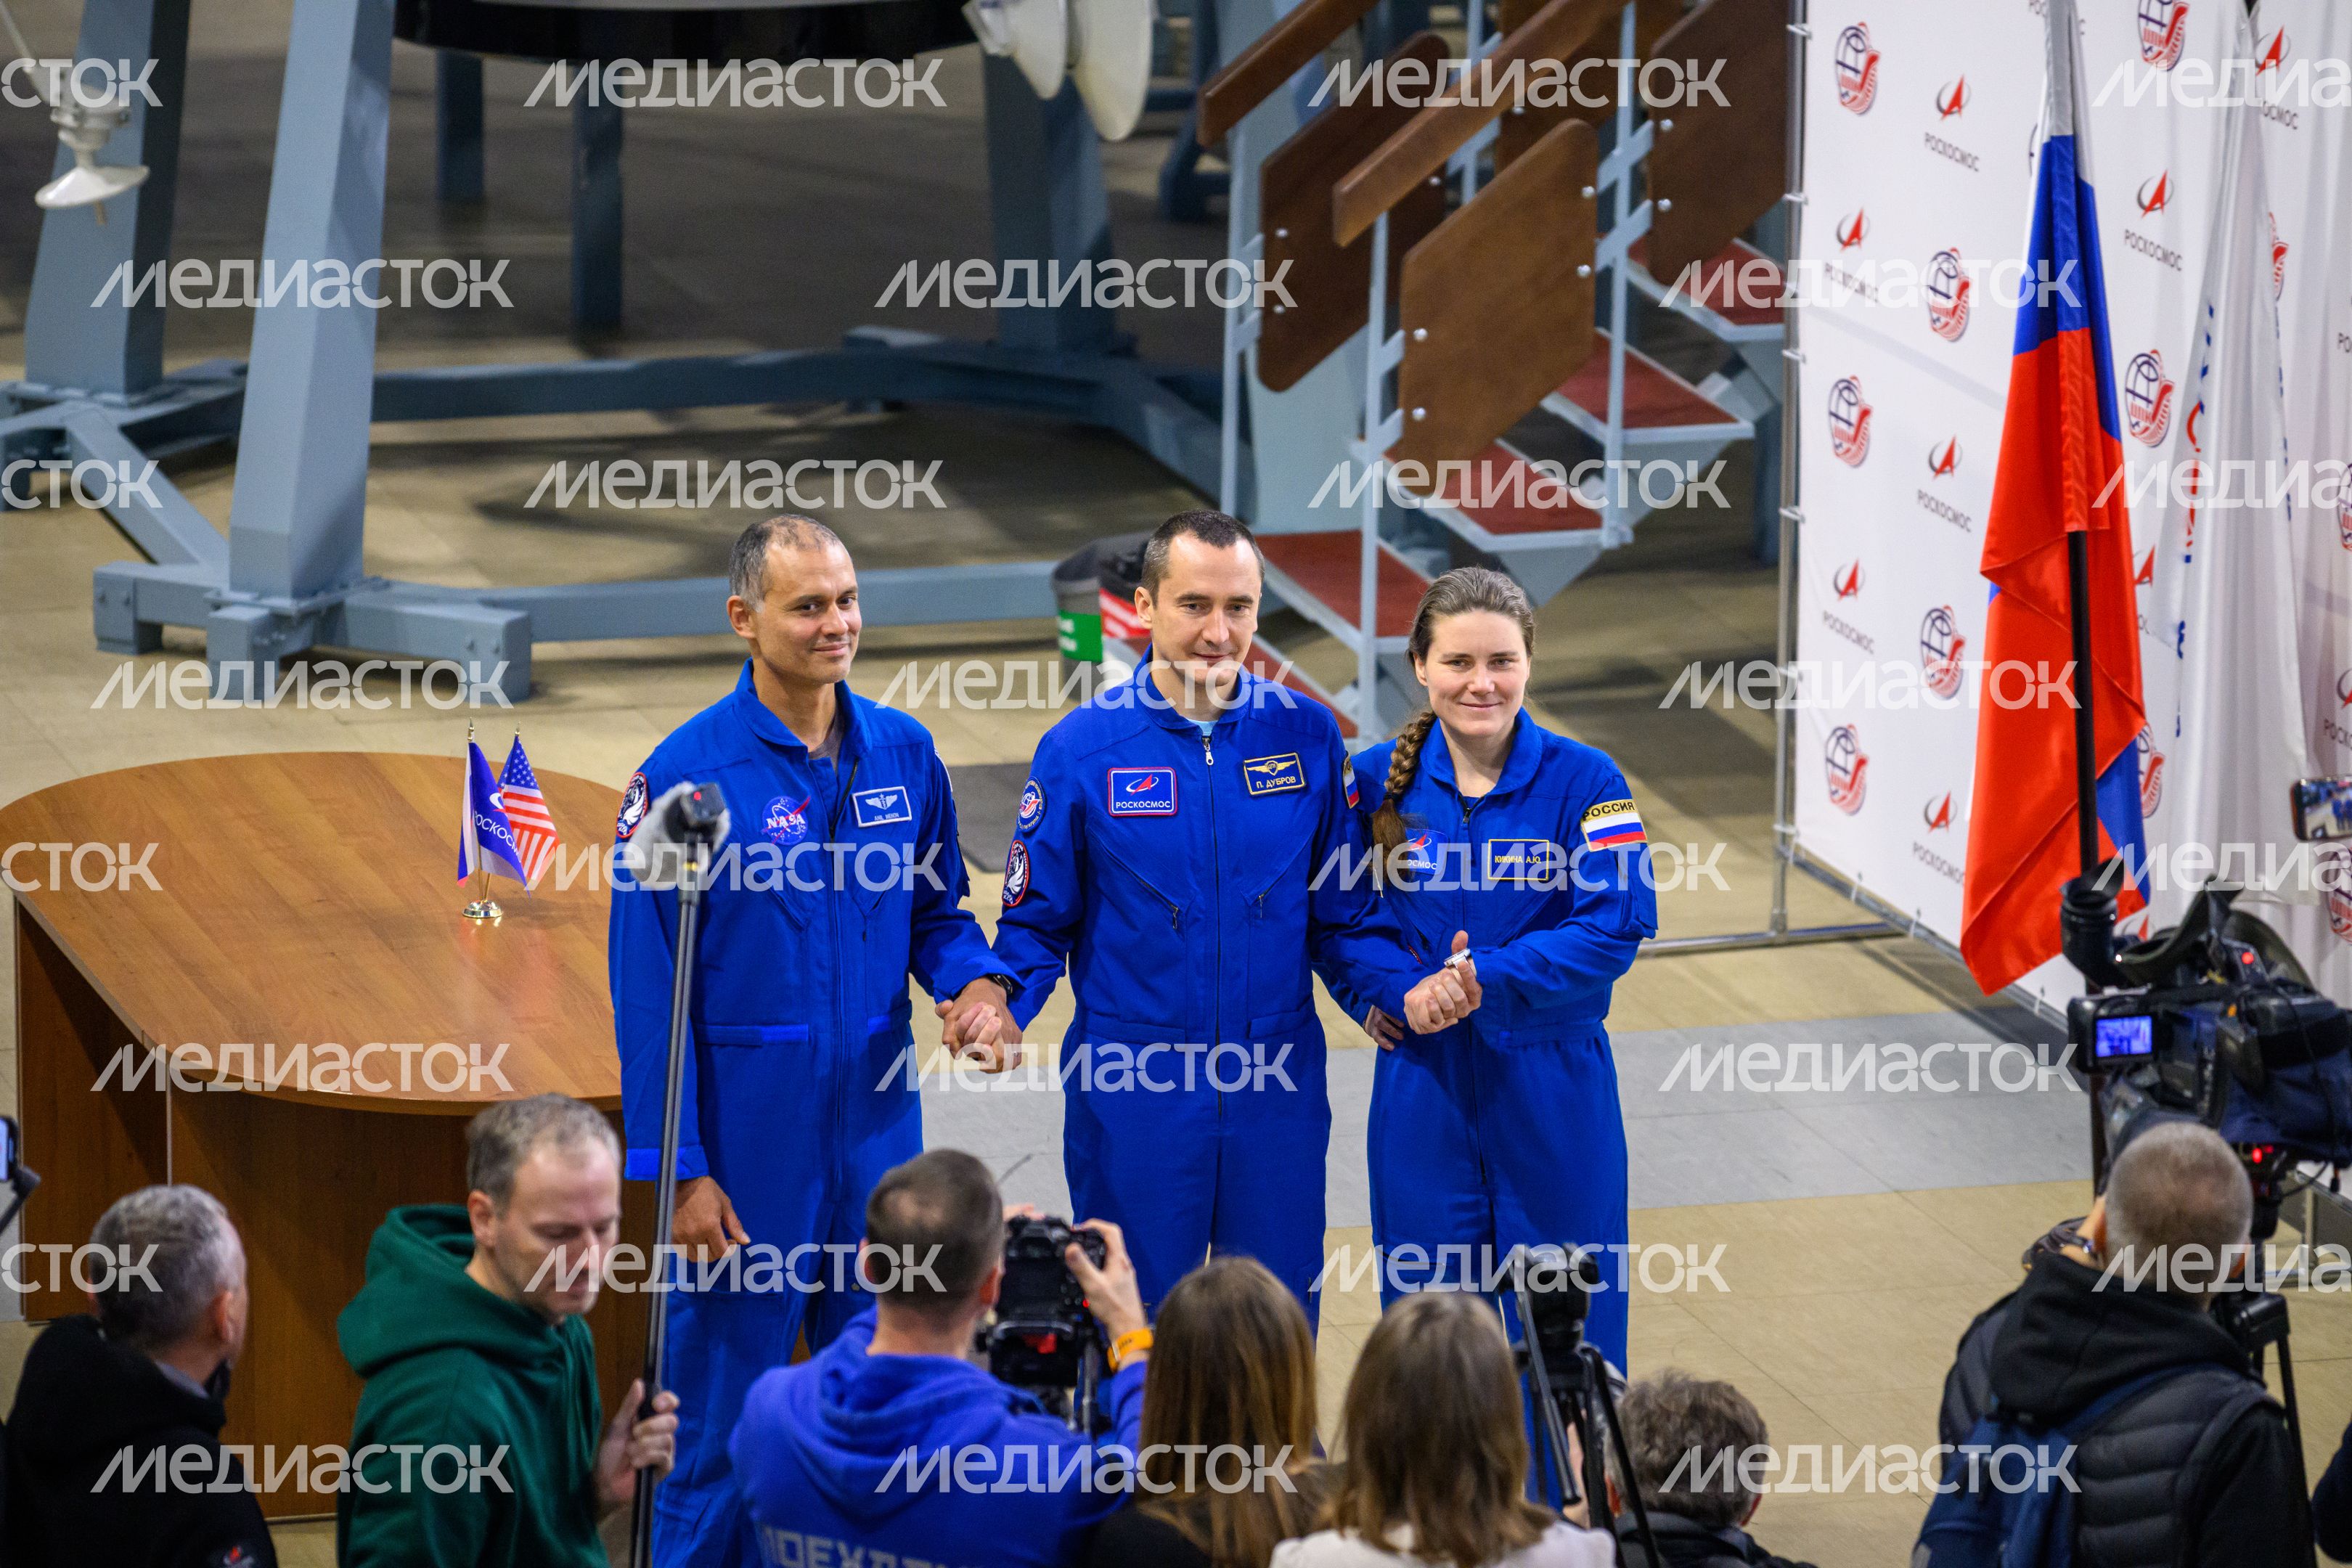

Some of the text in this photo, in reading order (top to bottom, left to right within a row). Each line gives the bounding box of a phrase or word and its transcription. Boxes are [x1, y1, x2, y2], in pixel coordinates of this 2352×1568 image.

[1924, 132, 1980, 172] РОСКОСМОС
[2124, 229, 2182, 271] РОСКОСМОС
[1917, 489, 1972, 533] РОСКОСМОС
[1823, 610, 1874, 655] РОСКОСМОС
[1256, 776, 1297, 789] П. ДУБРОВ
[766, 813, 806, 829] NASA
[1583, 801, 1635, 822] РОССИЯ
[1495, 855, 1523, 864] КИКИНА
